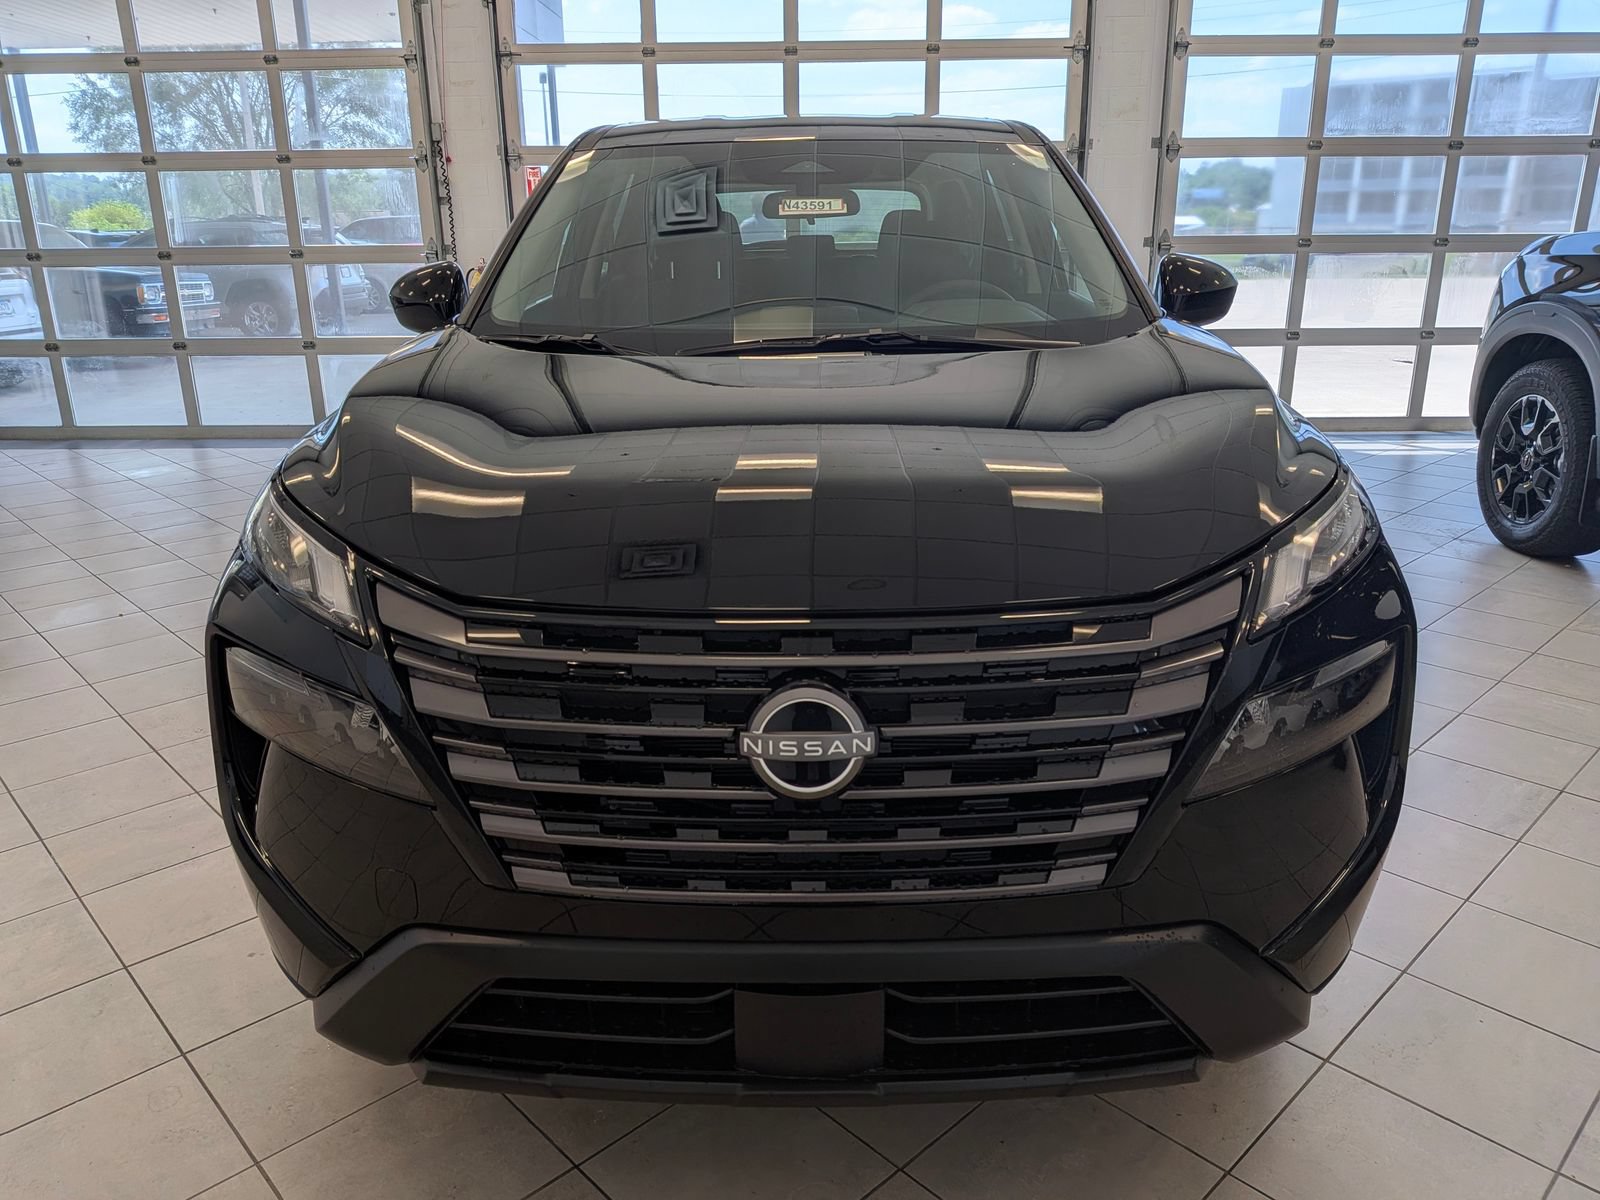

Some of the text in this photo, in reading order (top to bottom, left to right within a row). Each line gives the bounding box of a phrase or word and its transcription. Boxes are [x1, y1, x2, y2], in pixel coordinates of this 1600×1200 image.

[528, 170, 540, 178] FIRE
[783, 199, 832, 210] N43591
[743, 737, 871, 756] NISSAN
